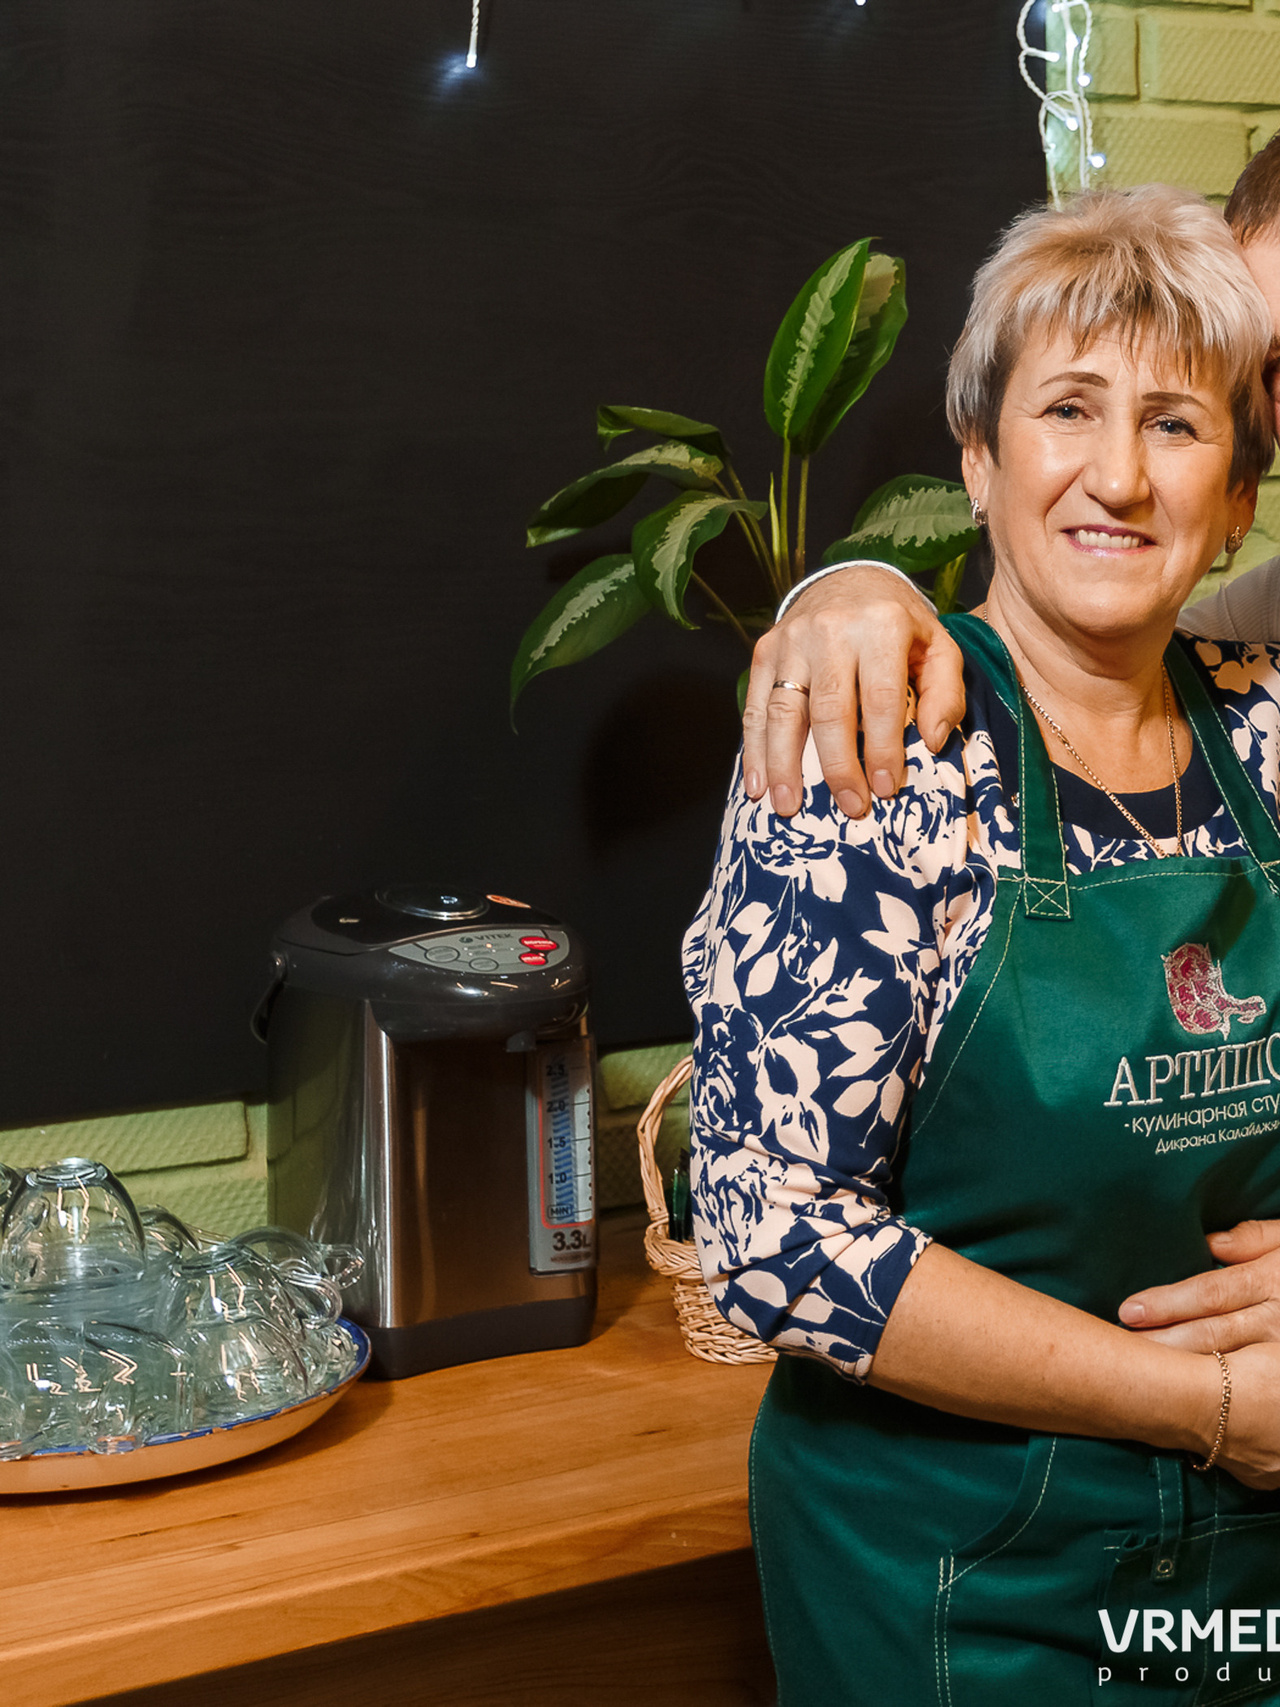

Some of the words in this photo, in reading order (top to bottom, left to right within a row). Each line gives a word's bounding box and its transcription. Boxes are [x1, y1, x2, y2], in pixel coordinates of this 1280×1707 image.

[546, 1100, 566, 1113] 2.0
[1132, 1101, 1248, 1137] кулинарная
[547, 1136, 567, 1149] 1.5
[1155, 1133, 1216, 1155] Дикрана
[548, 1172, 567, 1185] 1.0
[550, 1207, 569, 1217] MIN
